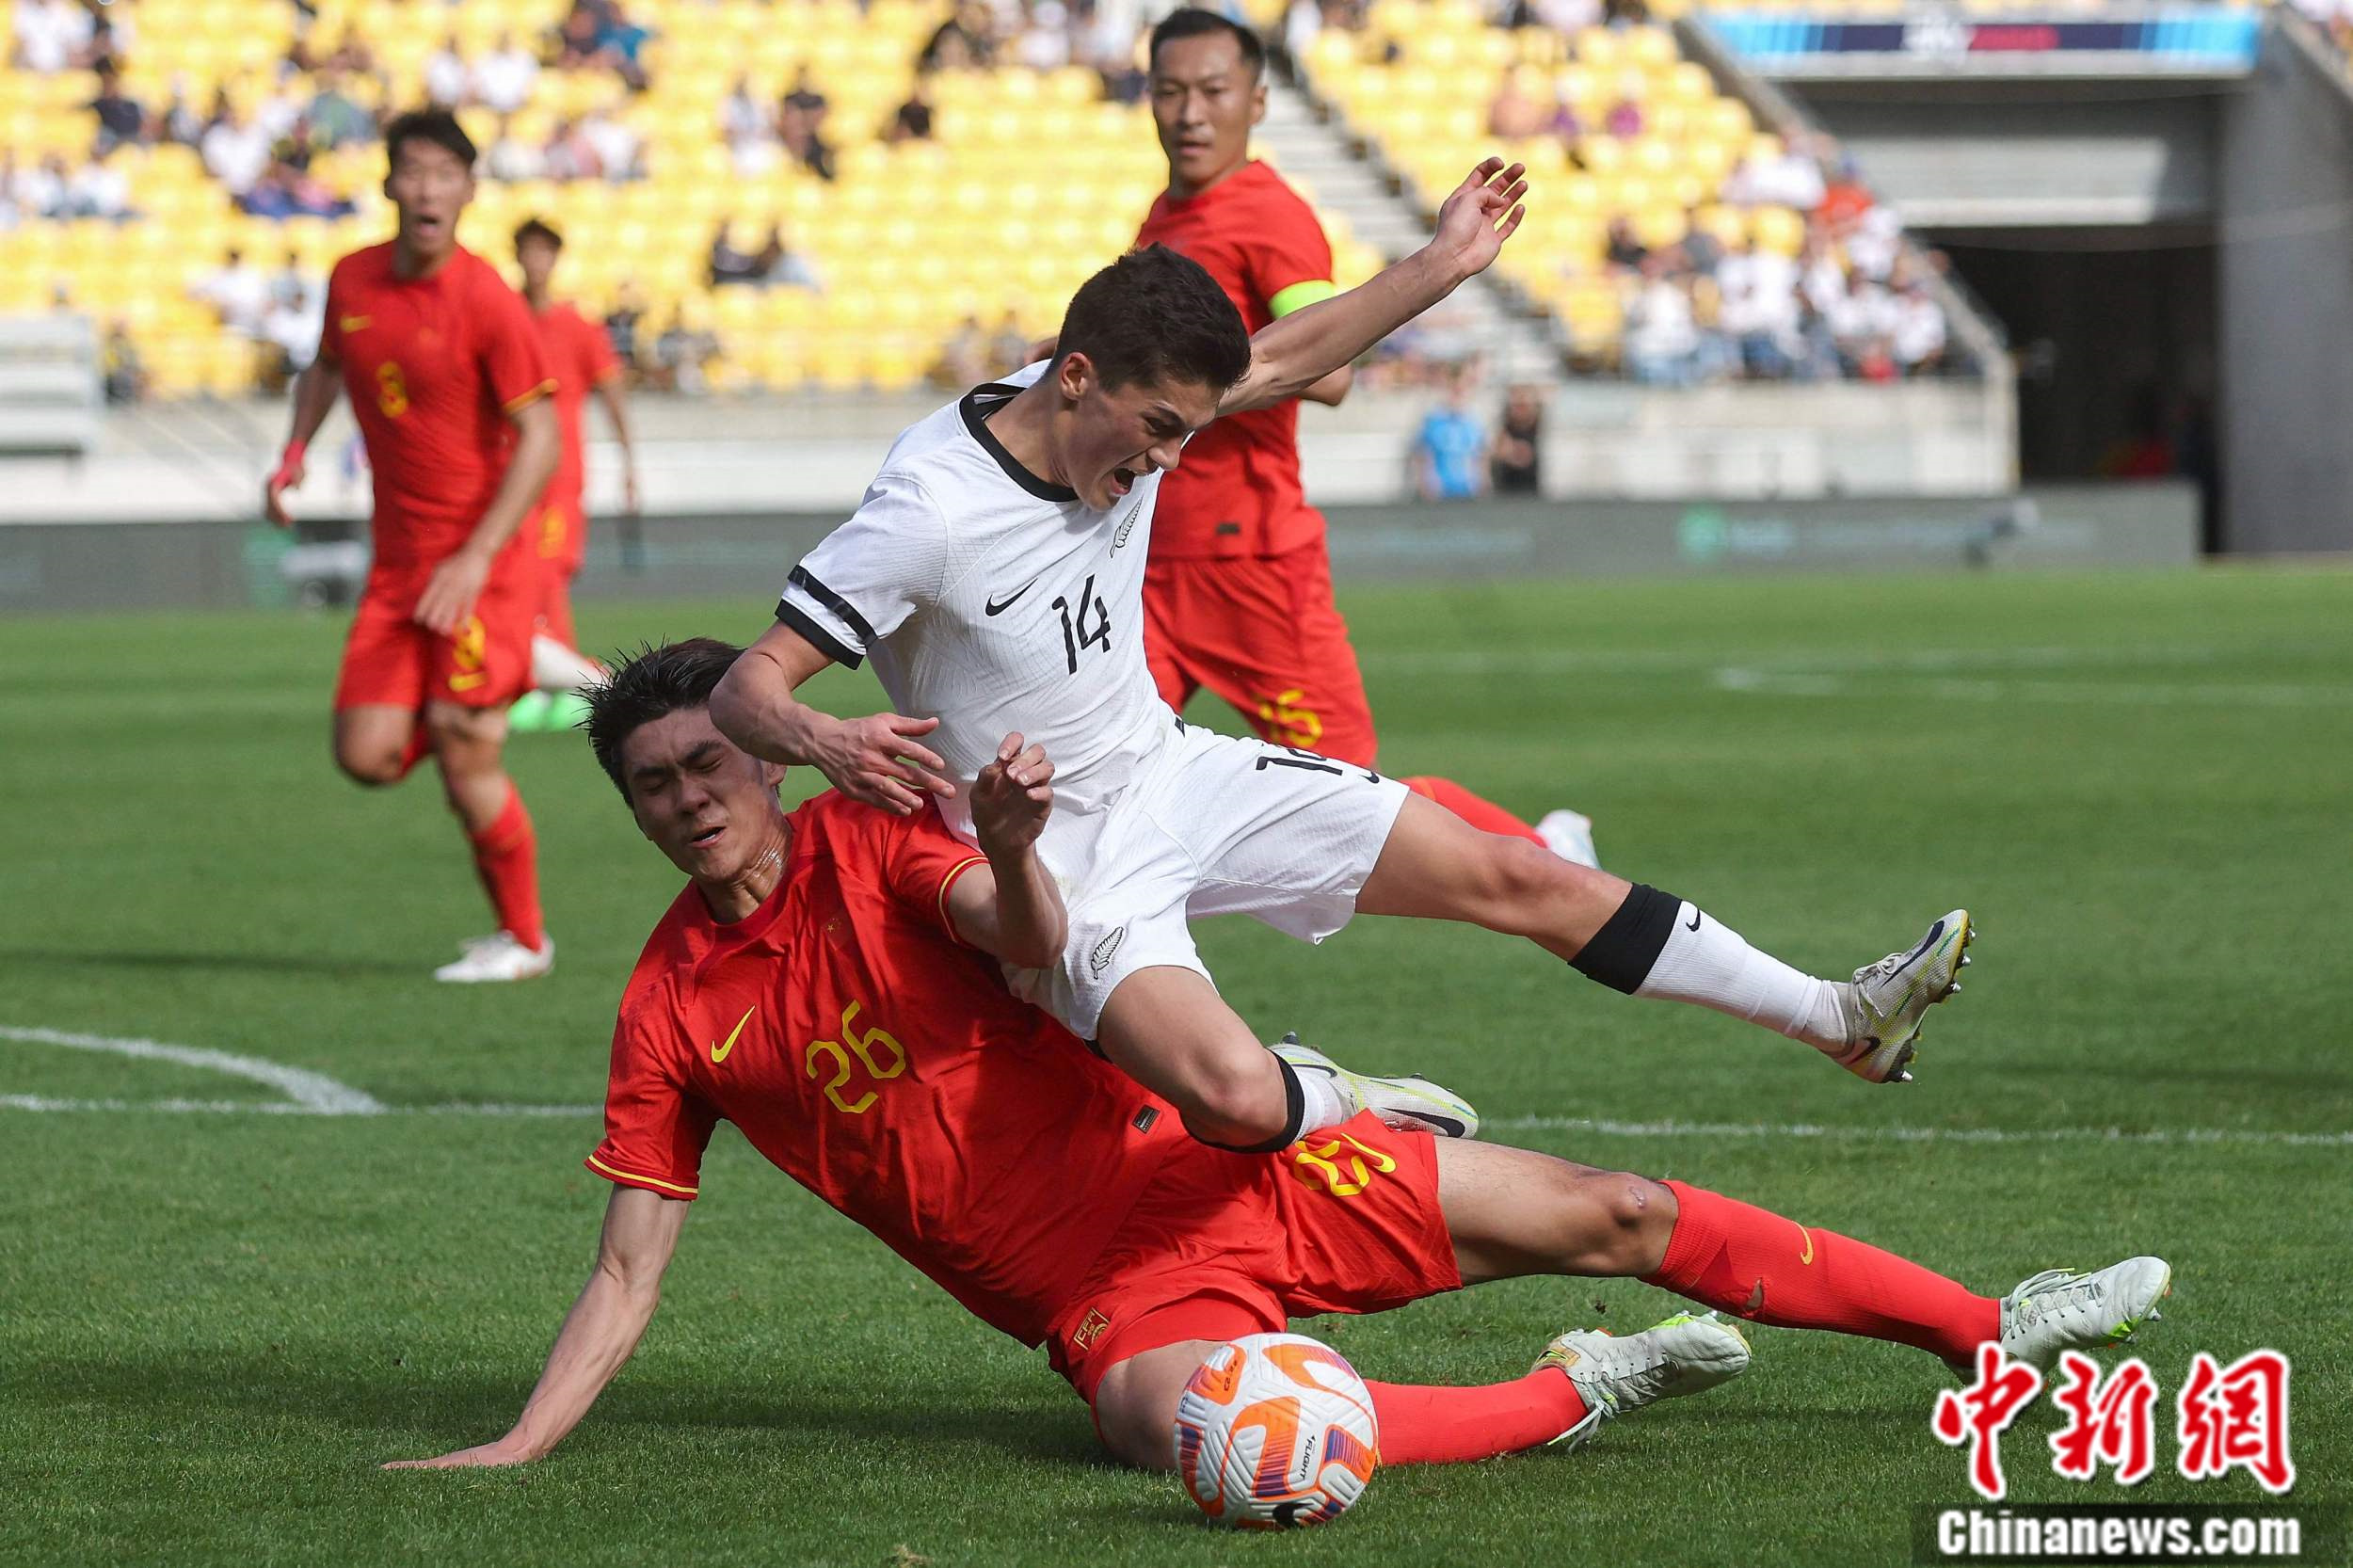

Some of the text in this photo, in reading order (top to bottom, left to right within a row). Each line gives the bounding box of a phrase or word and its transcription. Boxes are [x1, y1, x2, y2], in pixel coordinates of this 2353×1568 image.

[1051, 574, 1112, 675] 14
[807, 1000, 905, 1113] 26
[1299, 1437, 1313, 1480] FLIGHT
